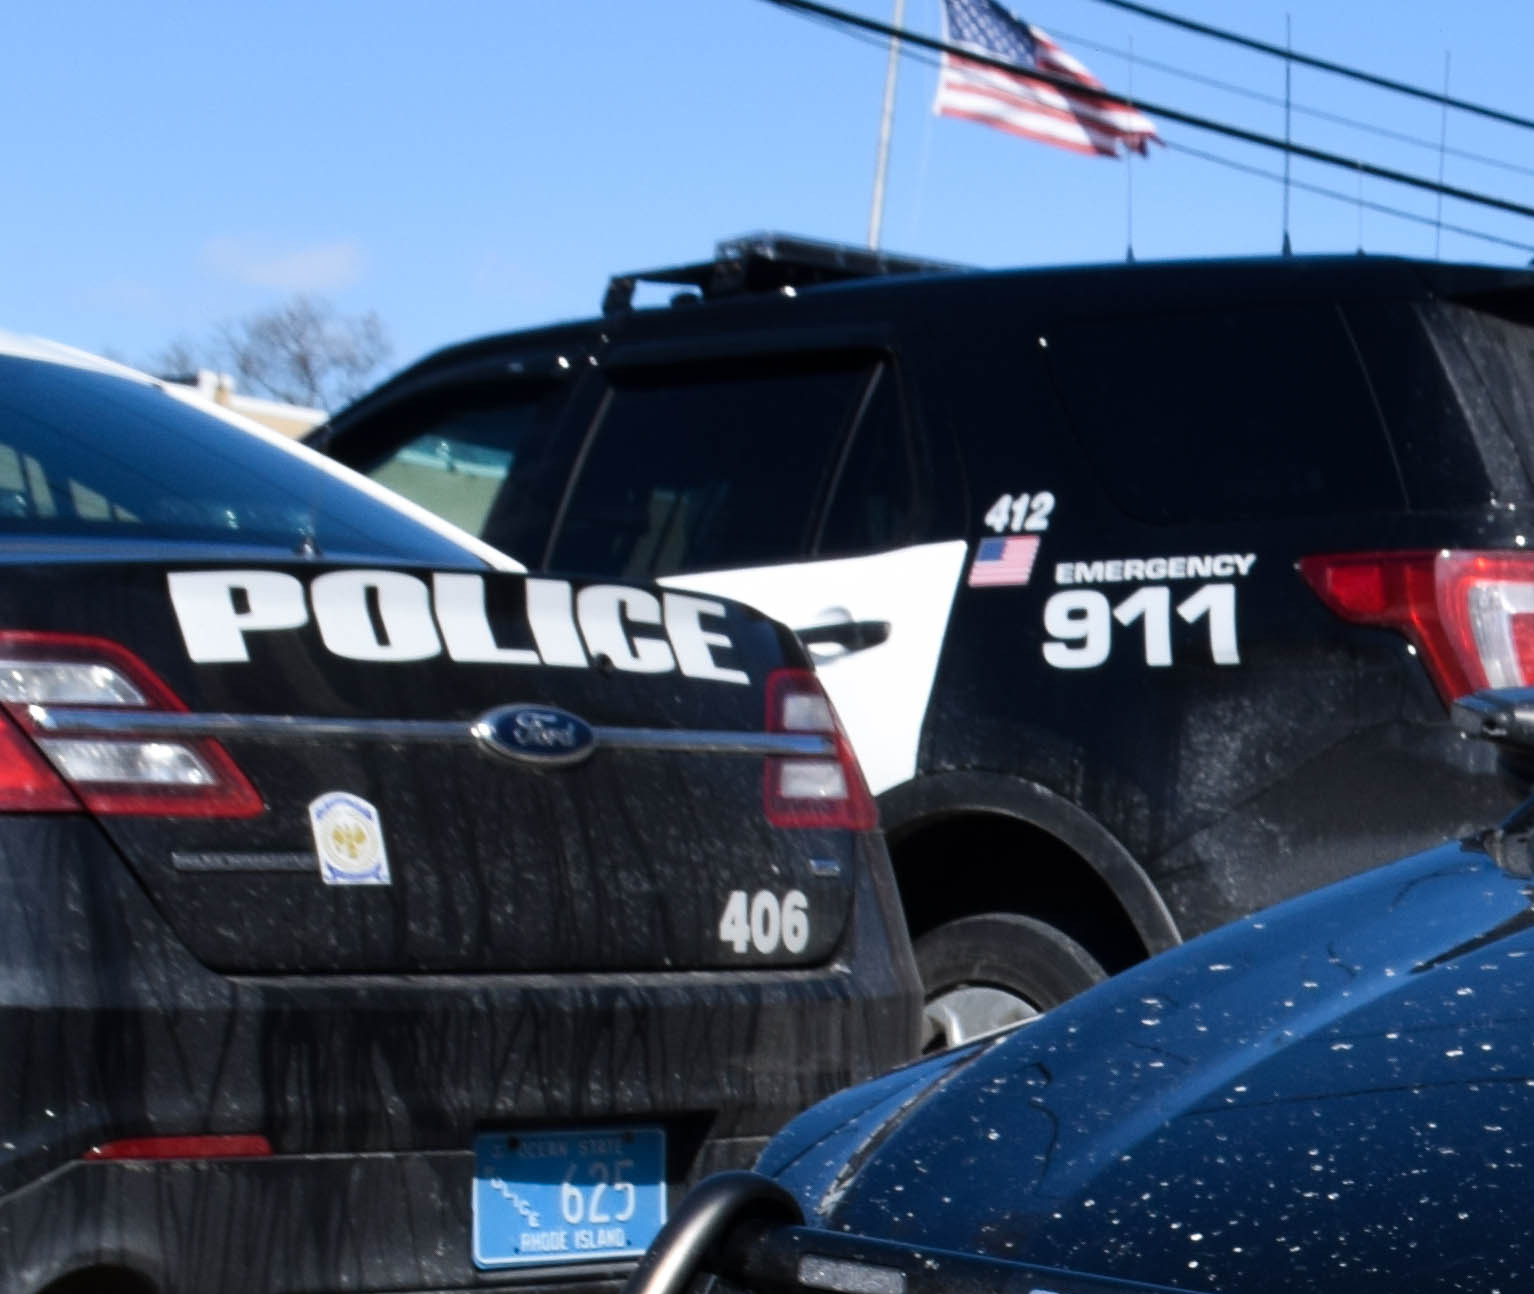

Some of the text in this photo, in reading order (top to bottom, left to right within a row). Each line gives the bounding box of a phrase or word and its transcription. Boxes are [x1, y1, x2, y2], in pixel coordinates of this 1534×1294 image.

[984, 491, 1056, 533] 412
[1054, 553, 1257, 585] EMERGENCY
[167, 569, 750, 685] POLICE
[1042, 583, 1241, 670] 911
[513, 710, 577, 747] Ford
[719, 889, 810, 955] 406
[561, 1158, 636, 1225] 625
[520, 1226, 626, 1252] RHODE ISLAND
